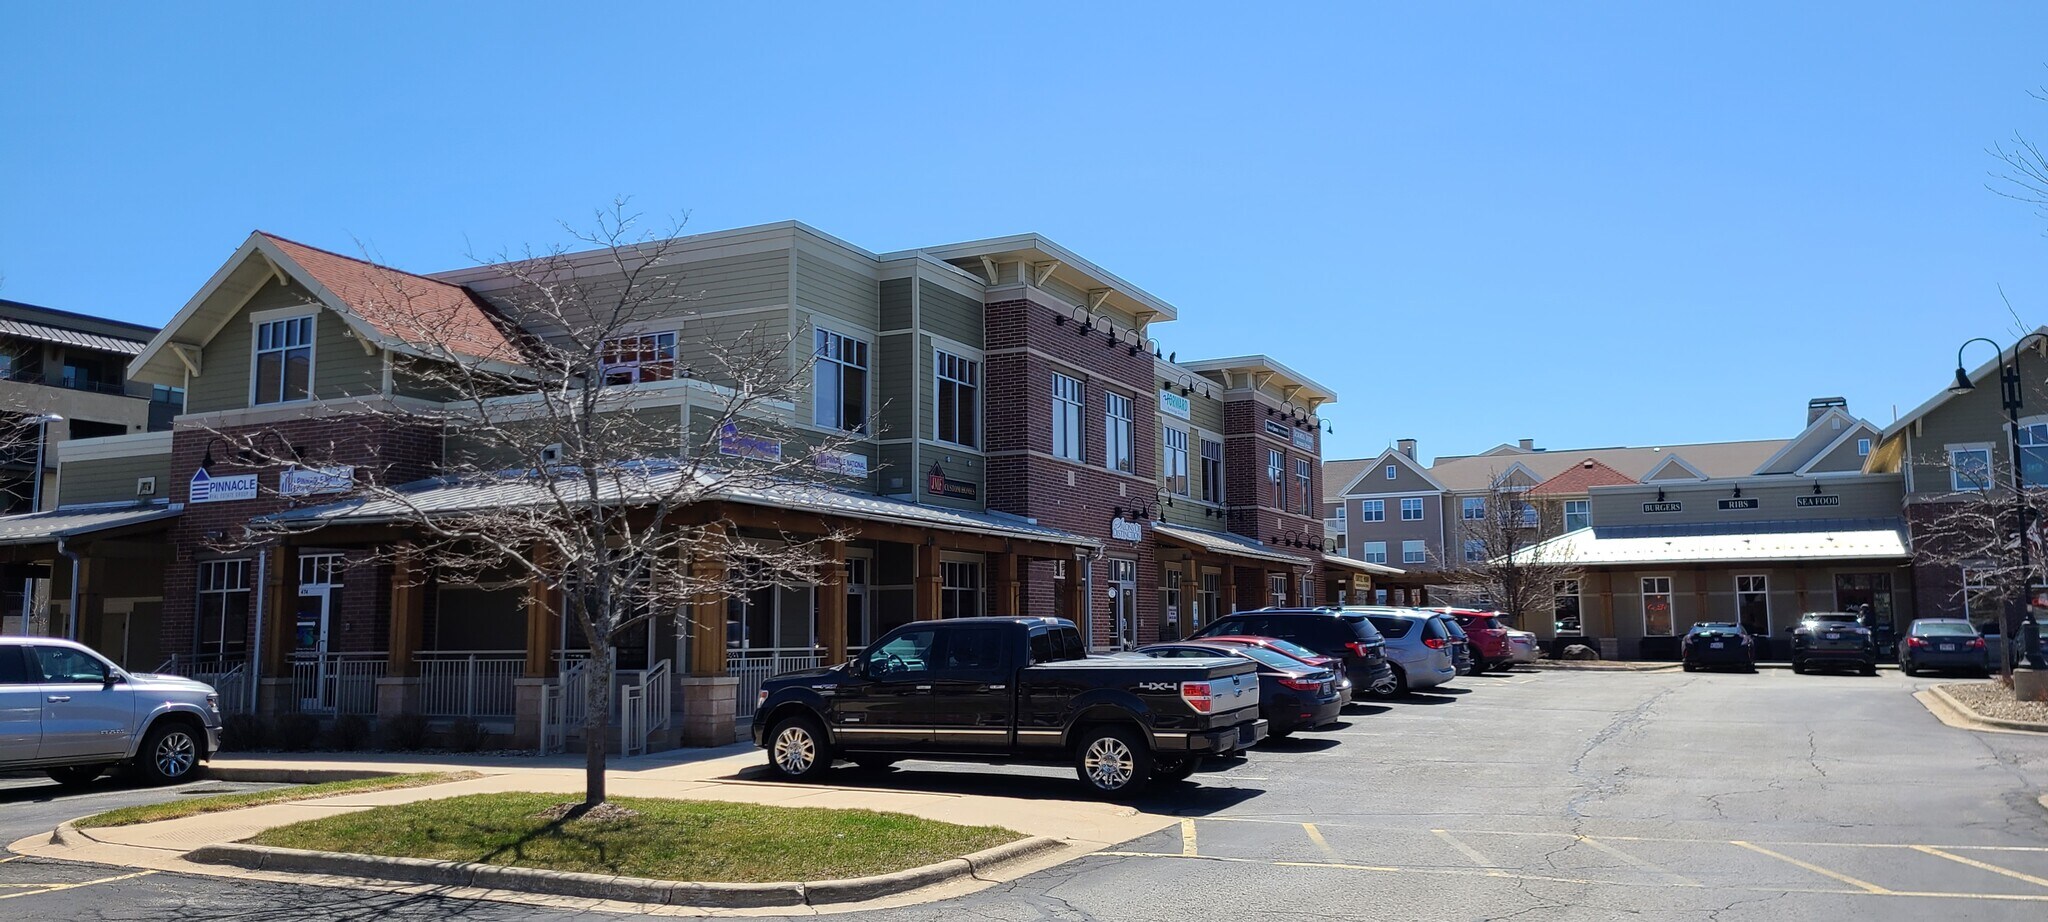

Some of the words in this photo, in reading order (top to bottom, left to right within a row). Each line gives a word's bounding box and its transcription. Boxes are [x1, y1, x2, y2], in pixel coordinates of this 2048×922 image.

[209, 478, 256, 493] PINNACLE
[944, 483, 961, 494] CUSTOM
[1728, 501, 1749, 509] RIBS
[1815, 496, 1838, 505] FOOD
[1644, 503, 1681, 512] BURGERS
